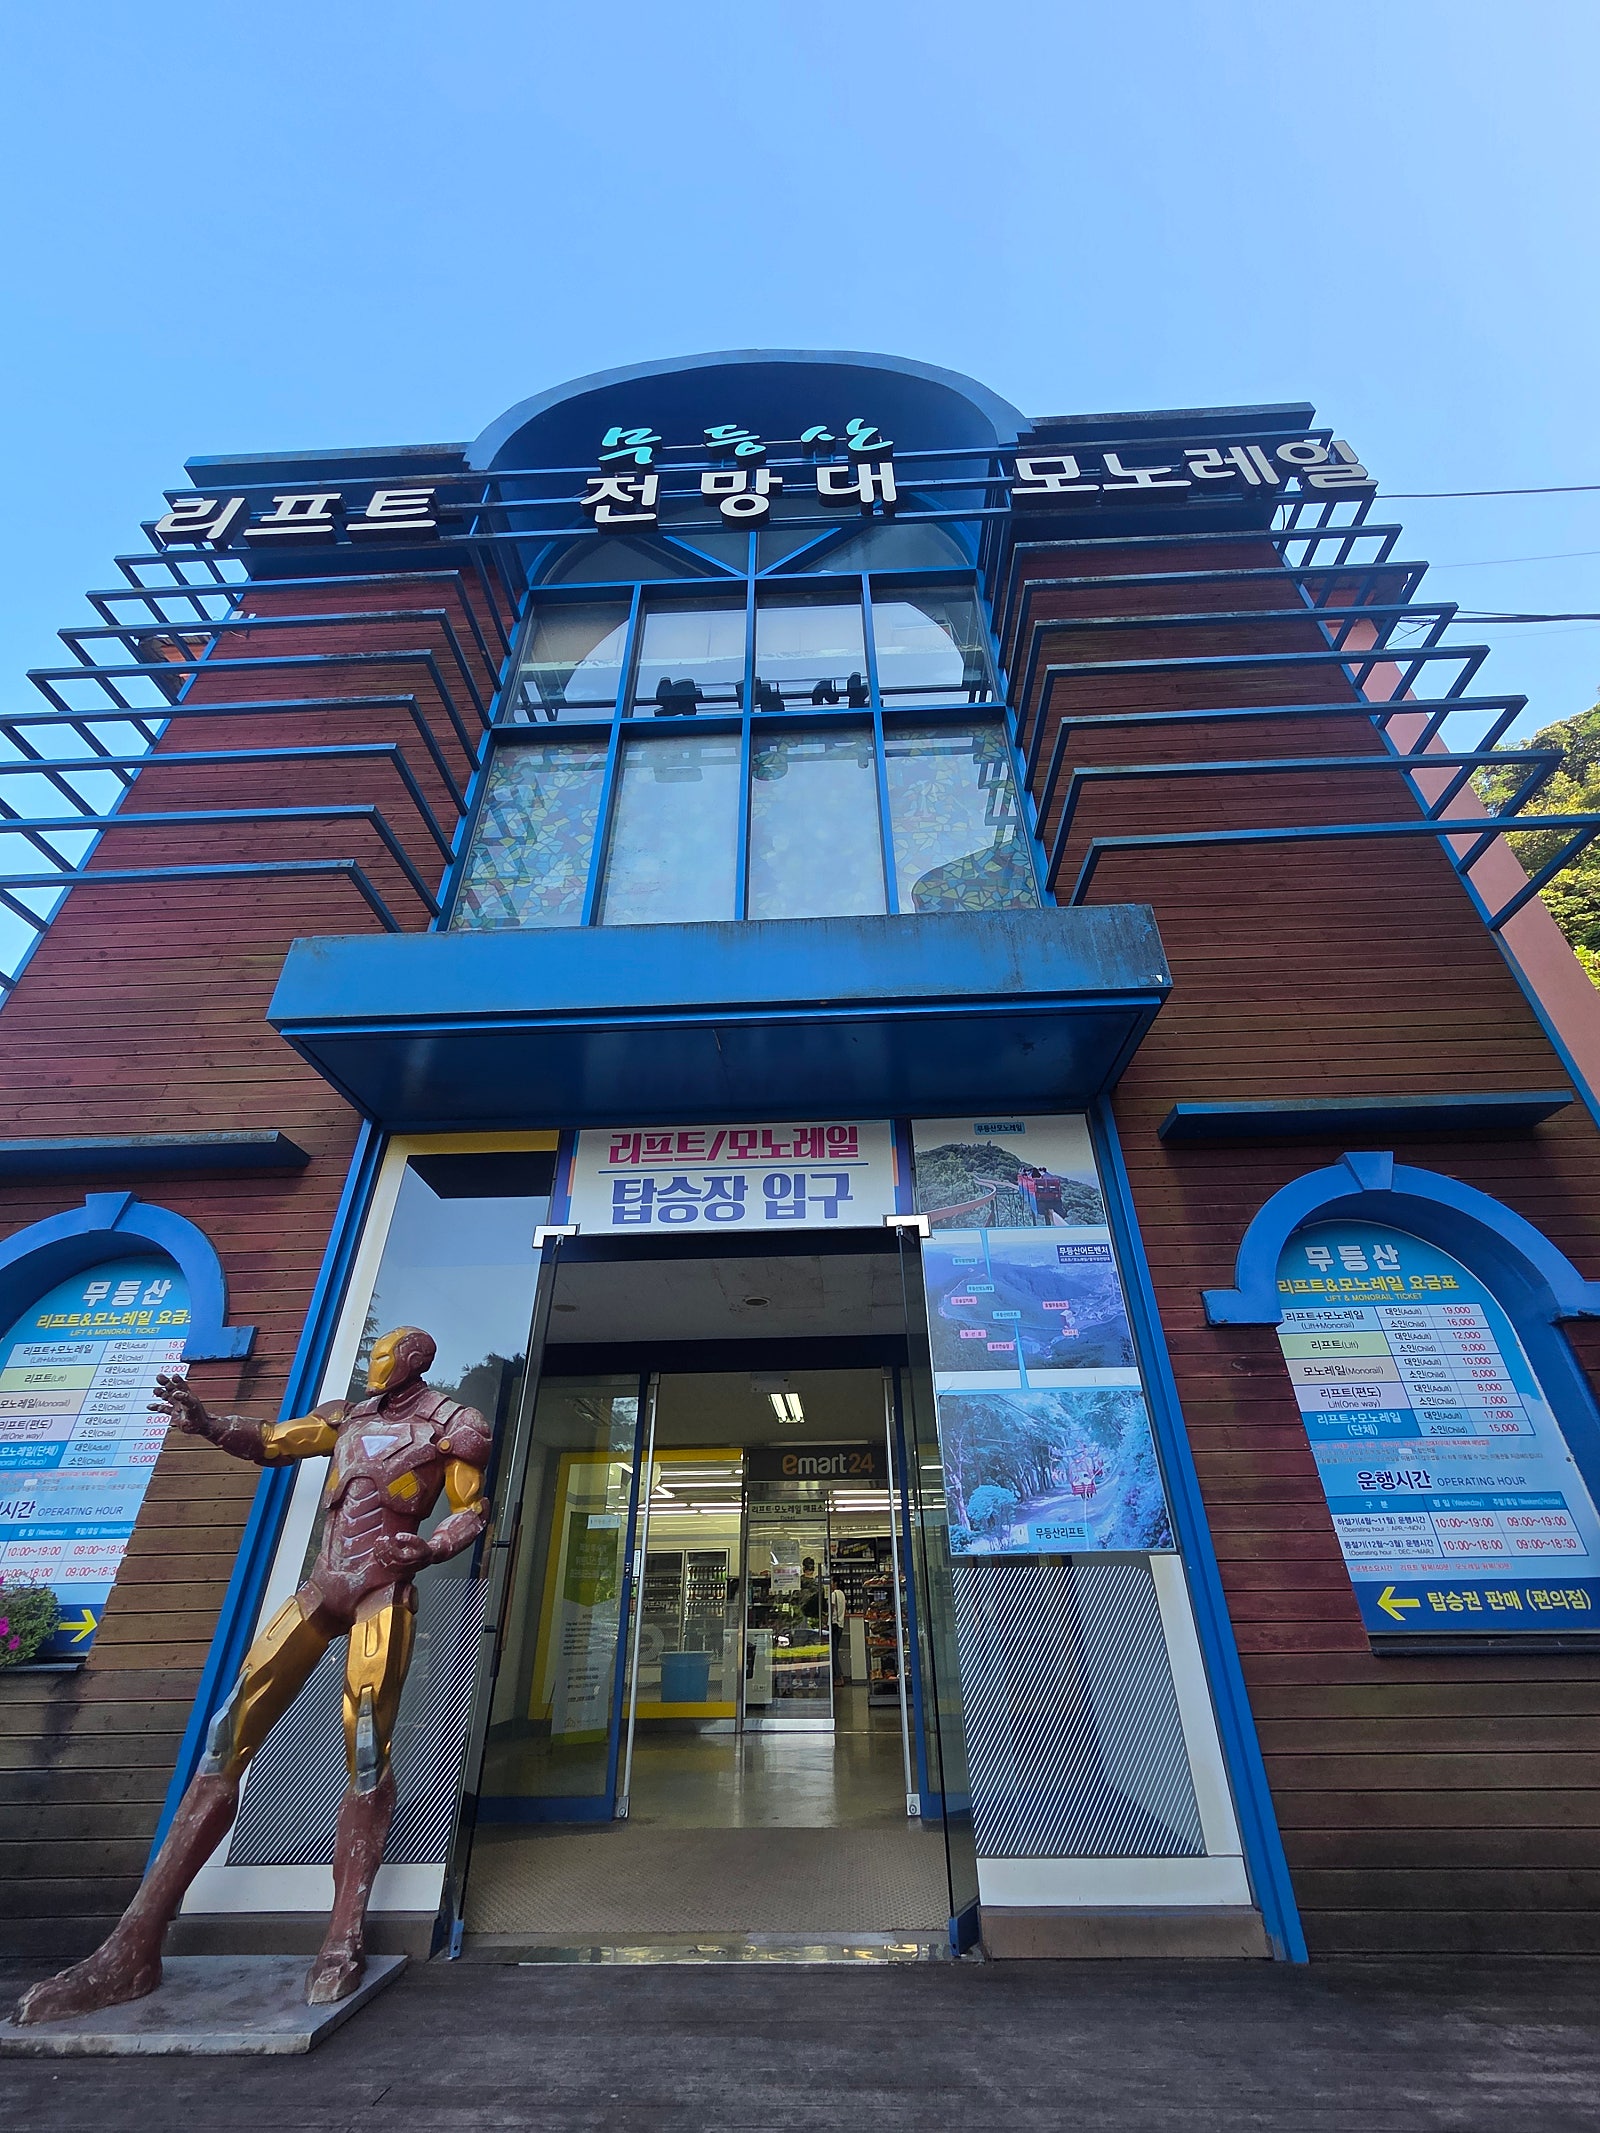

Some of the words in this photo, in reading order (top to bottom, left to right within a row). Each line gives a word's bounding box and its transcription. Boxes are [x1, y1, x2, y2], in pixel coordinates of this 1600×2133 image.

[1011, 440, 1379, 494] 모노레일
[580, 462, 897, 523] 전망대
[154, 488, 436, 539] 리프트
[609, 1126, 859, 1164] 리프트/모노레일
[612, 1175, 748, 1224] 탑승장
[763, 1172, 854, 1220] 입구
[1304, 1244, 1401, 1273] 무등산
[82, 1279, 173, 1307] 무등산
[1276, 1275, 1405, 1295] 리프트&모노레일
[1408, 1274, 1460, 1291] 요금표
[1351, 1293, 1394, 1301] MONORAIL
[1396, 1292, 1423, 1300] TICKET
[36, 1309, 153, 1329] 리프트&모노레일
[155, 1308, 191, 1325] 요금
[1285, 1309, 1365, 1322] 리프트+모노레일
[1319, 1386, 1382, 1399] 리프트(편도)
[1316, 1411, 1402, 1425] 리프트+모노레일
[1357, 1470, 1433, 1491] 운행시간
[1437, 1476, 1495, 1487] OPERATING
[1499, 1475, 1527, 1486] HOUR
[0, 1500, 36, 1519] 시간
[37, 1506, 93, 1516] OPERATING
[95, 1506, 124, 1515] HOUR
[1435, 1517, 1494, 1528] 10:00~19:00
[1506, 1516, 1567, 1527] 09:00~19:00
[1035, 1527, 1086, 1539] 무등산리프트
[1443, 1539, 1503, 1551] 10:00~18:00
[1516, 1538, 1577, 1549] 09:00~18:30
[1427, 1590, 1484, 1612] 탑승권
[1485, 1590, 1523, 1611] 판매
[1526, 1588, 1592, 1611] (편의점)
